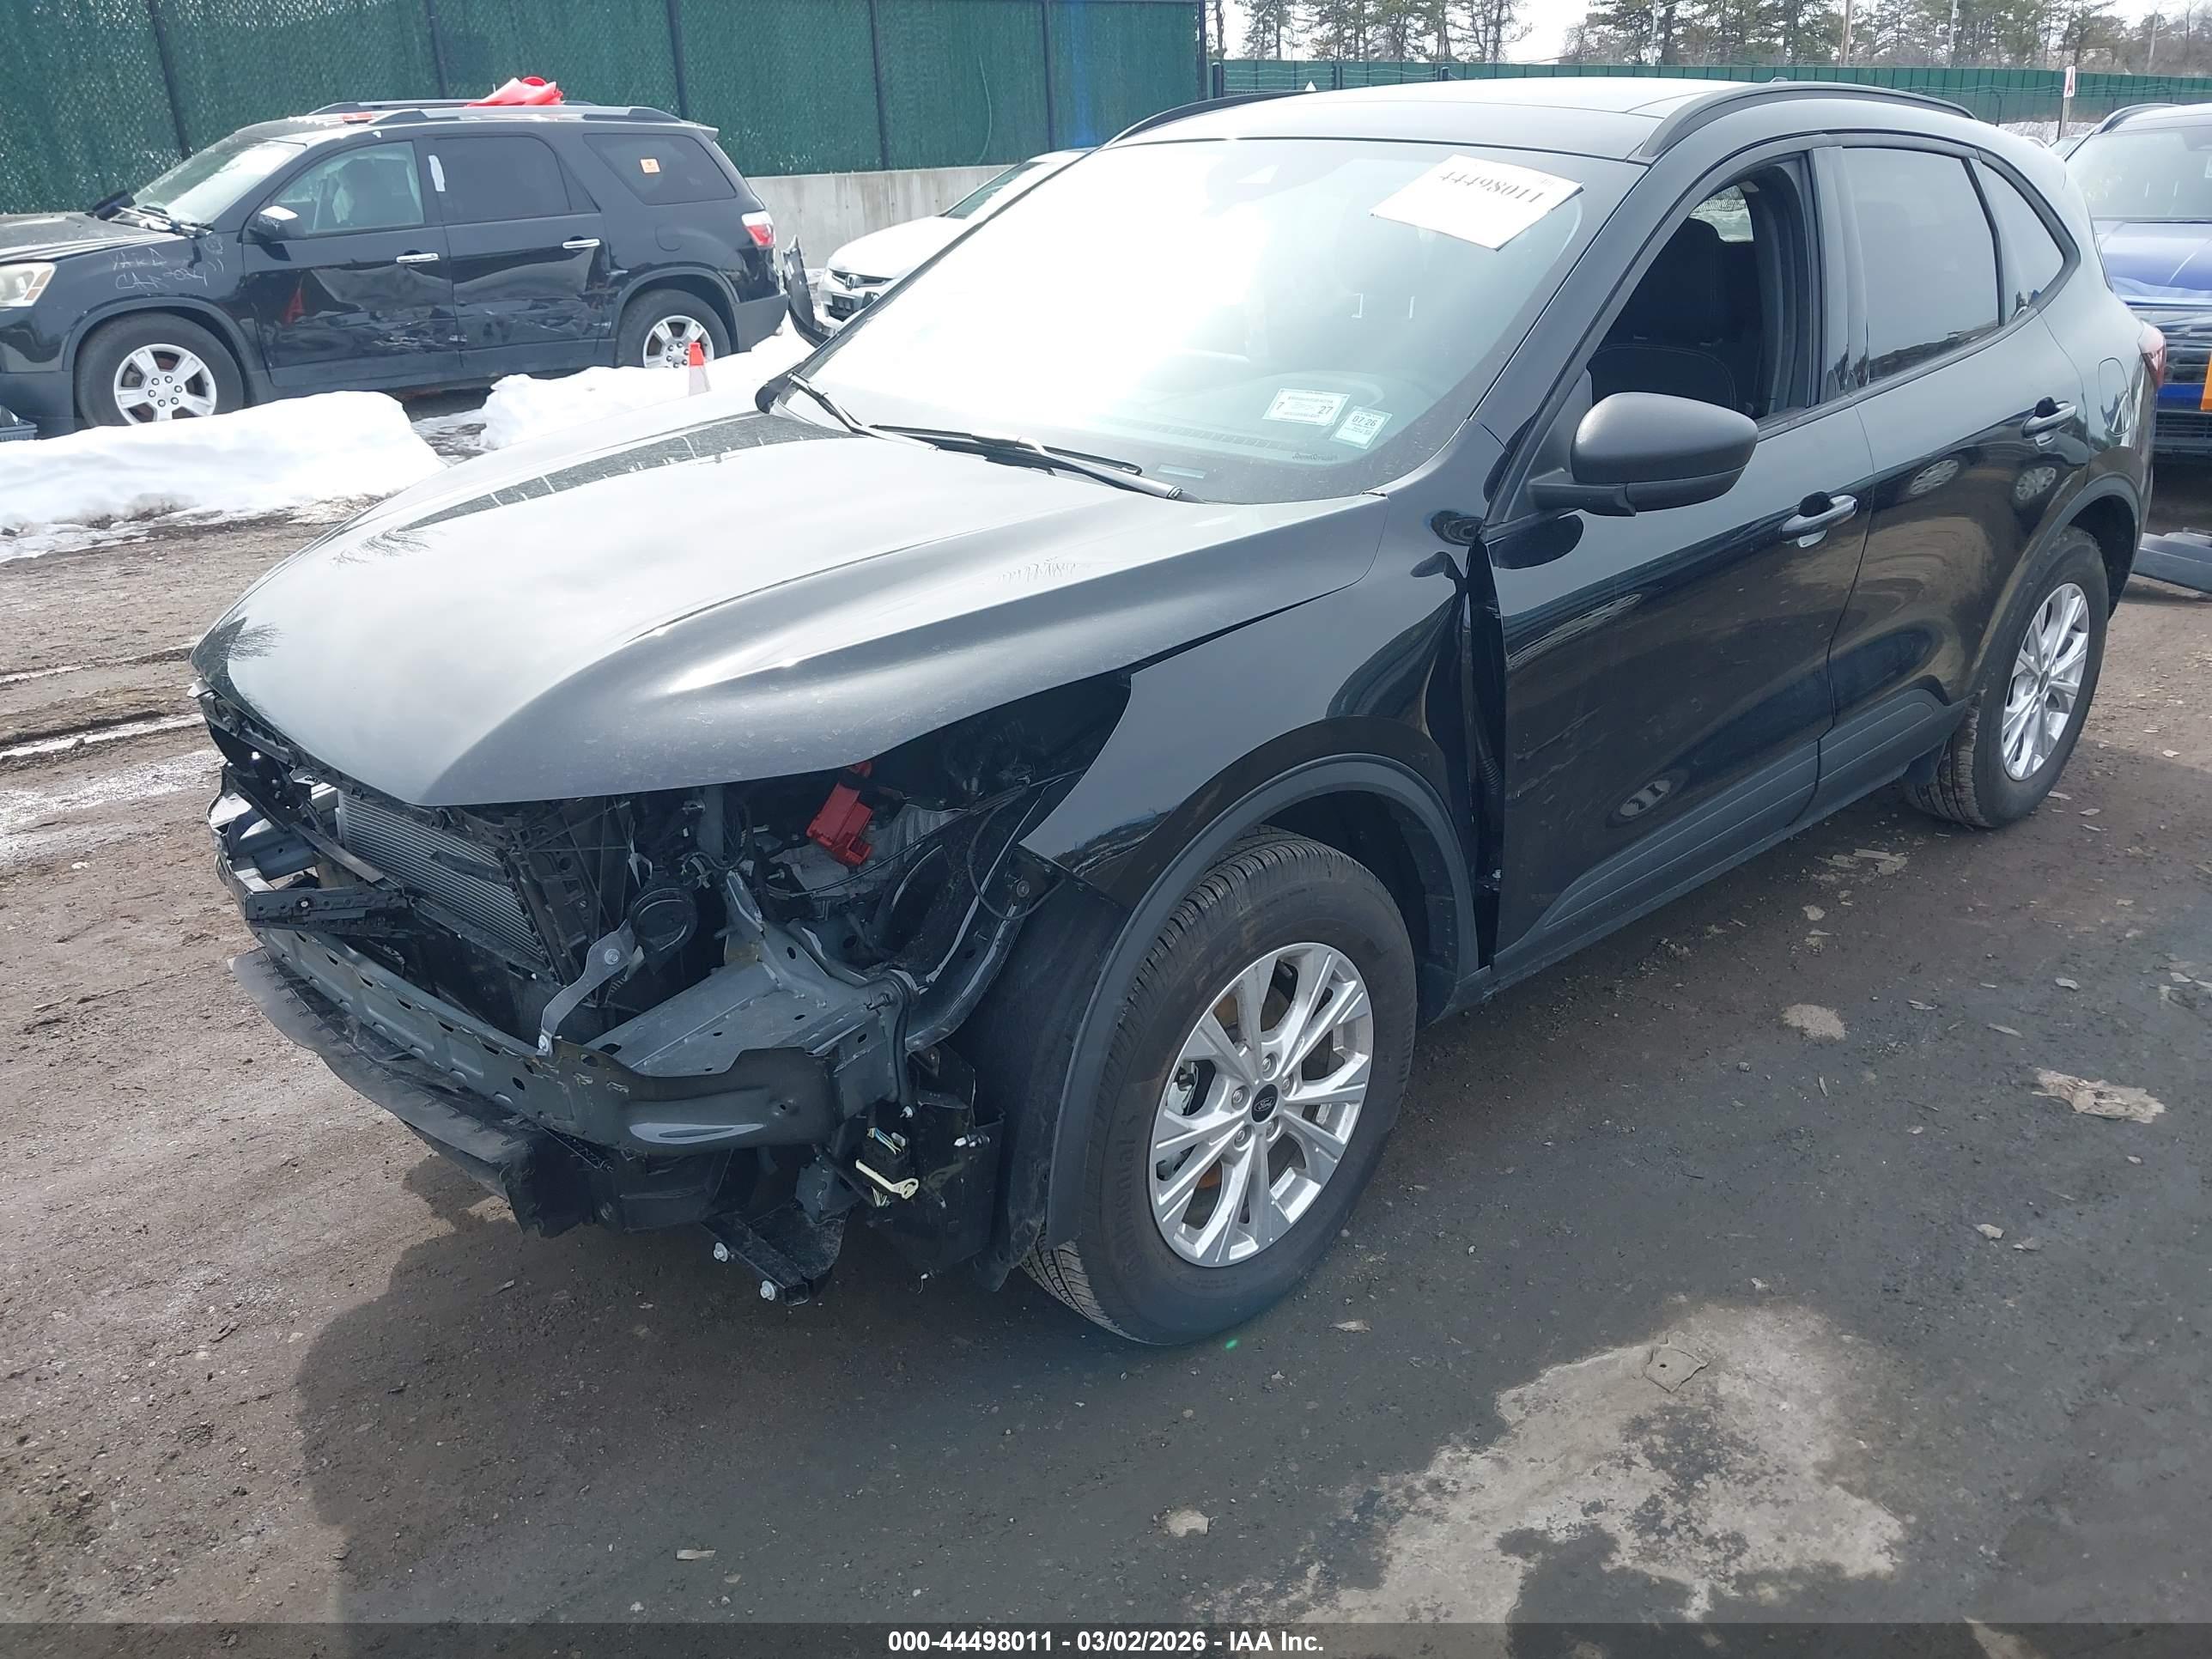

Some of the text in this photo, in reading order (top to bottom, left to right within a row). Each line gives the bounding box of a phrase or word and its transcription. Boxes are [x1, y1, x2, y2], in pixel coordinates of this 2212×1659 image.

[2066, 68, 2074, 94] A
[1439, 171, 1545, 203] 44498011
[1318, 406, 1334, 415] 27
